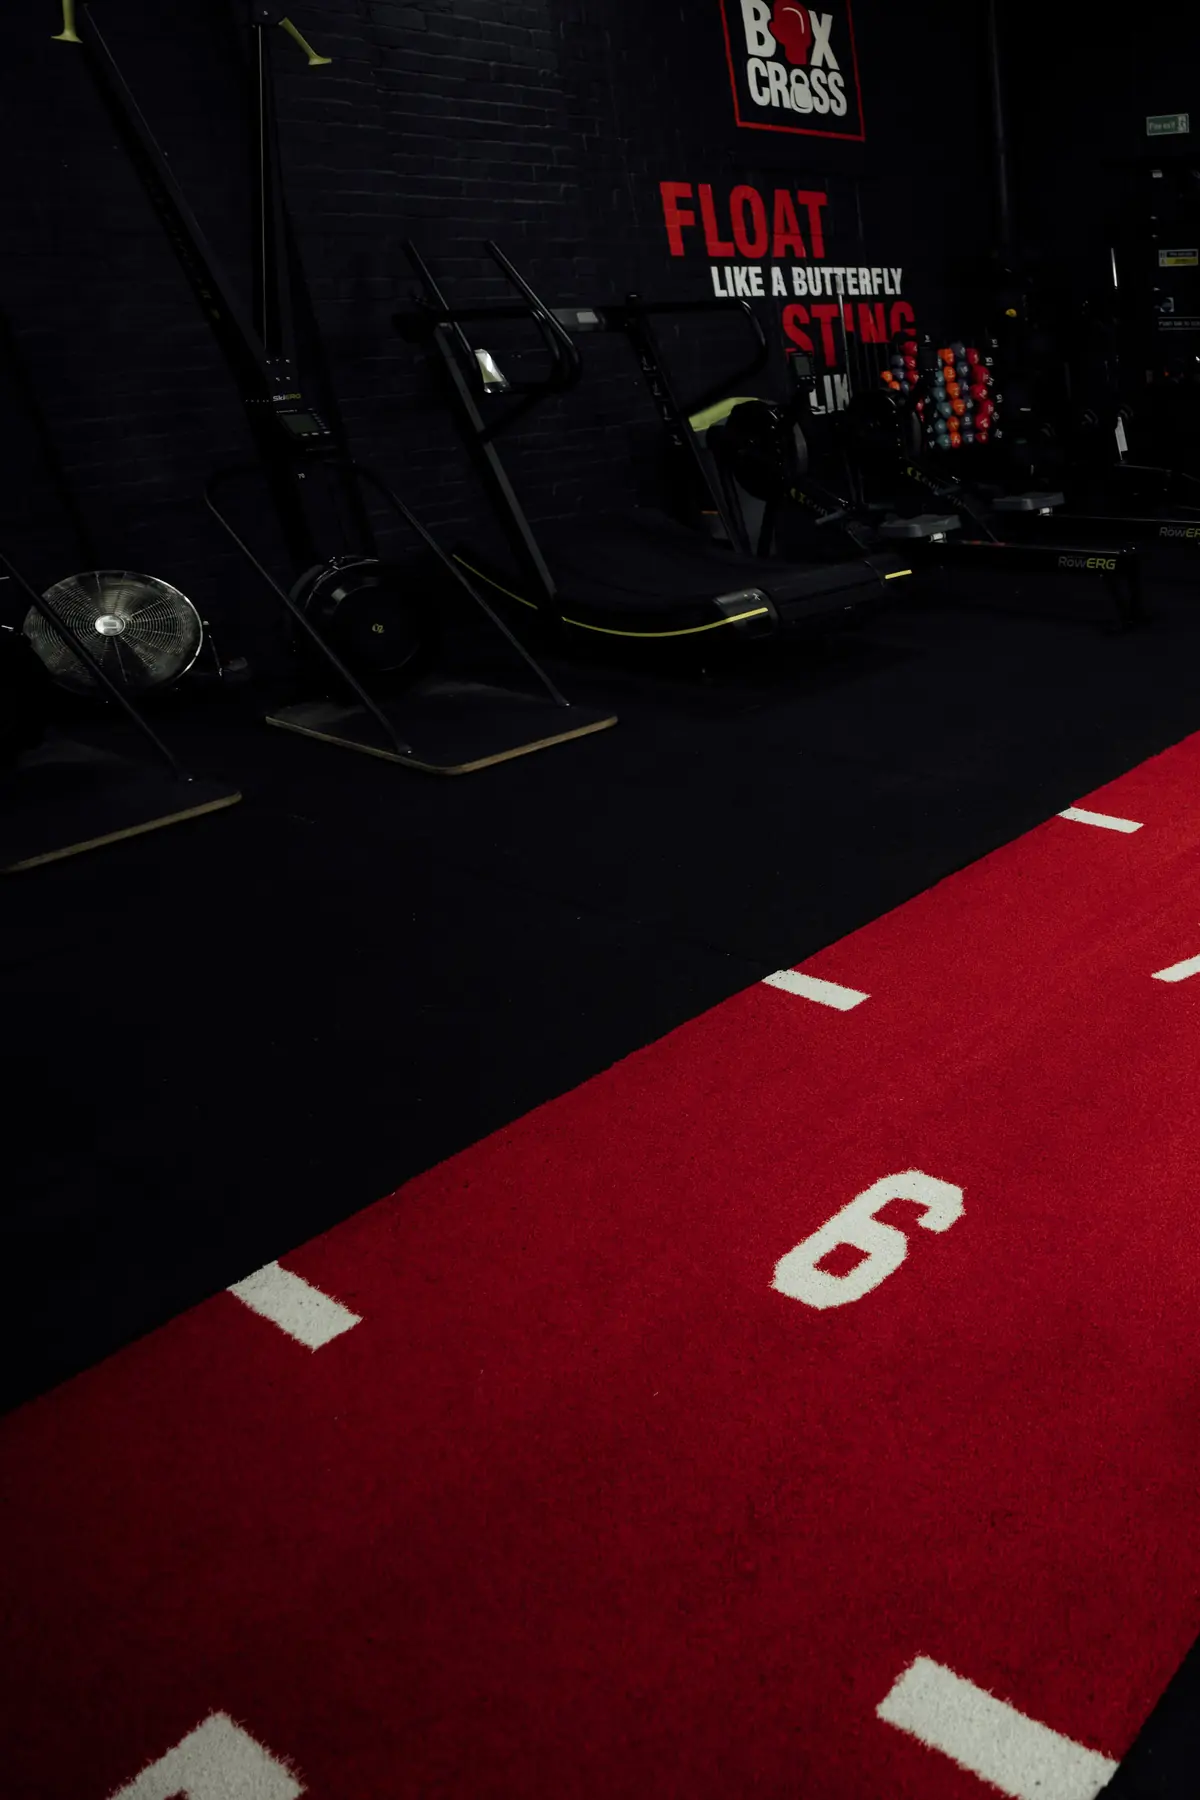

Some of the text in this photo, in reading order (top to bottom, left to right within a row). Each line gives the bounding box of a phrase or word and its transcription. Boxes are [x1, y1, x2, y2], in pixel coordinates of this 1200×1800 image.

[746, 57, 848, 116] CROSS
[659, 181, 829, 259] FLOAT
[710, 266, 903, 297] LIKE A BUTTERFLY
[769, 1166, 967, 1311] 6
